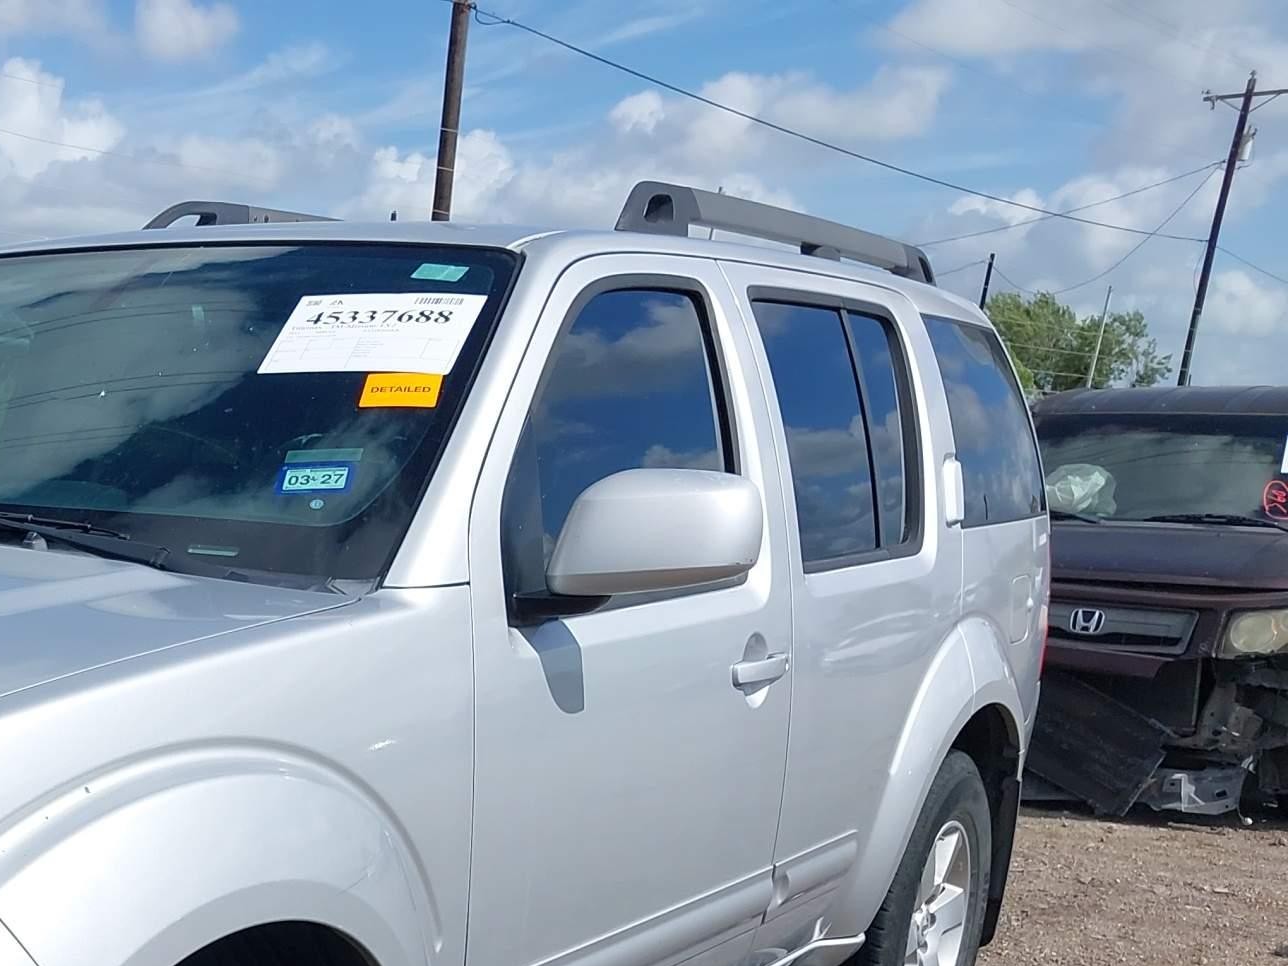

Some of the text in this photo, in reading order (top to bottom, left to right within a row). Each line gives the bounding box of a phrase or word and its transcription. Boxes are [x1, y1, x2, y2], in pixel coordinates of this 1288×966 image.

[306, 310, 453, 326] 45337688
[370, 385, 431, 394] DETAILED
[288, 473, 344, 486] 03 27
